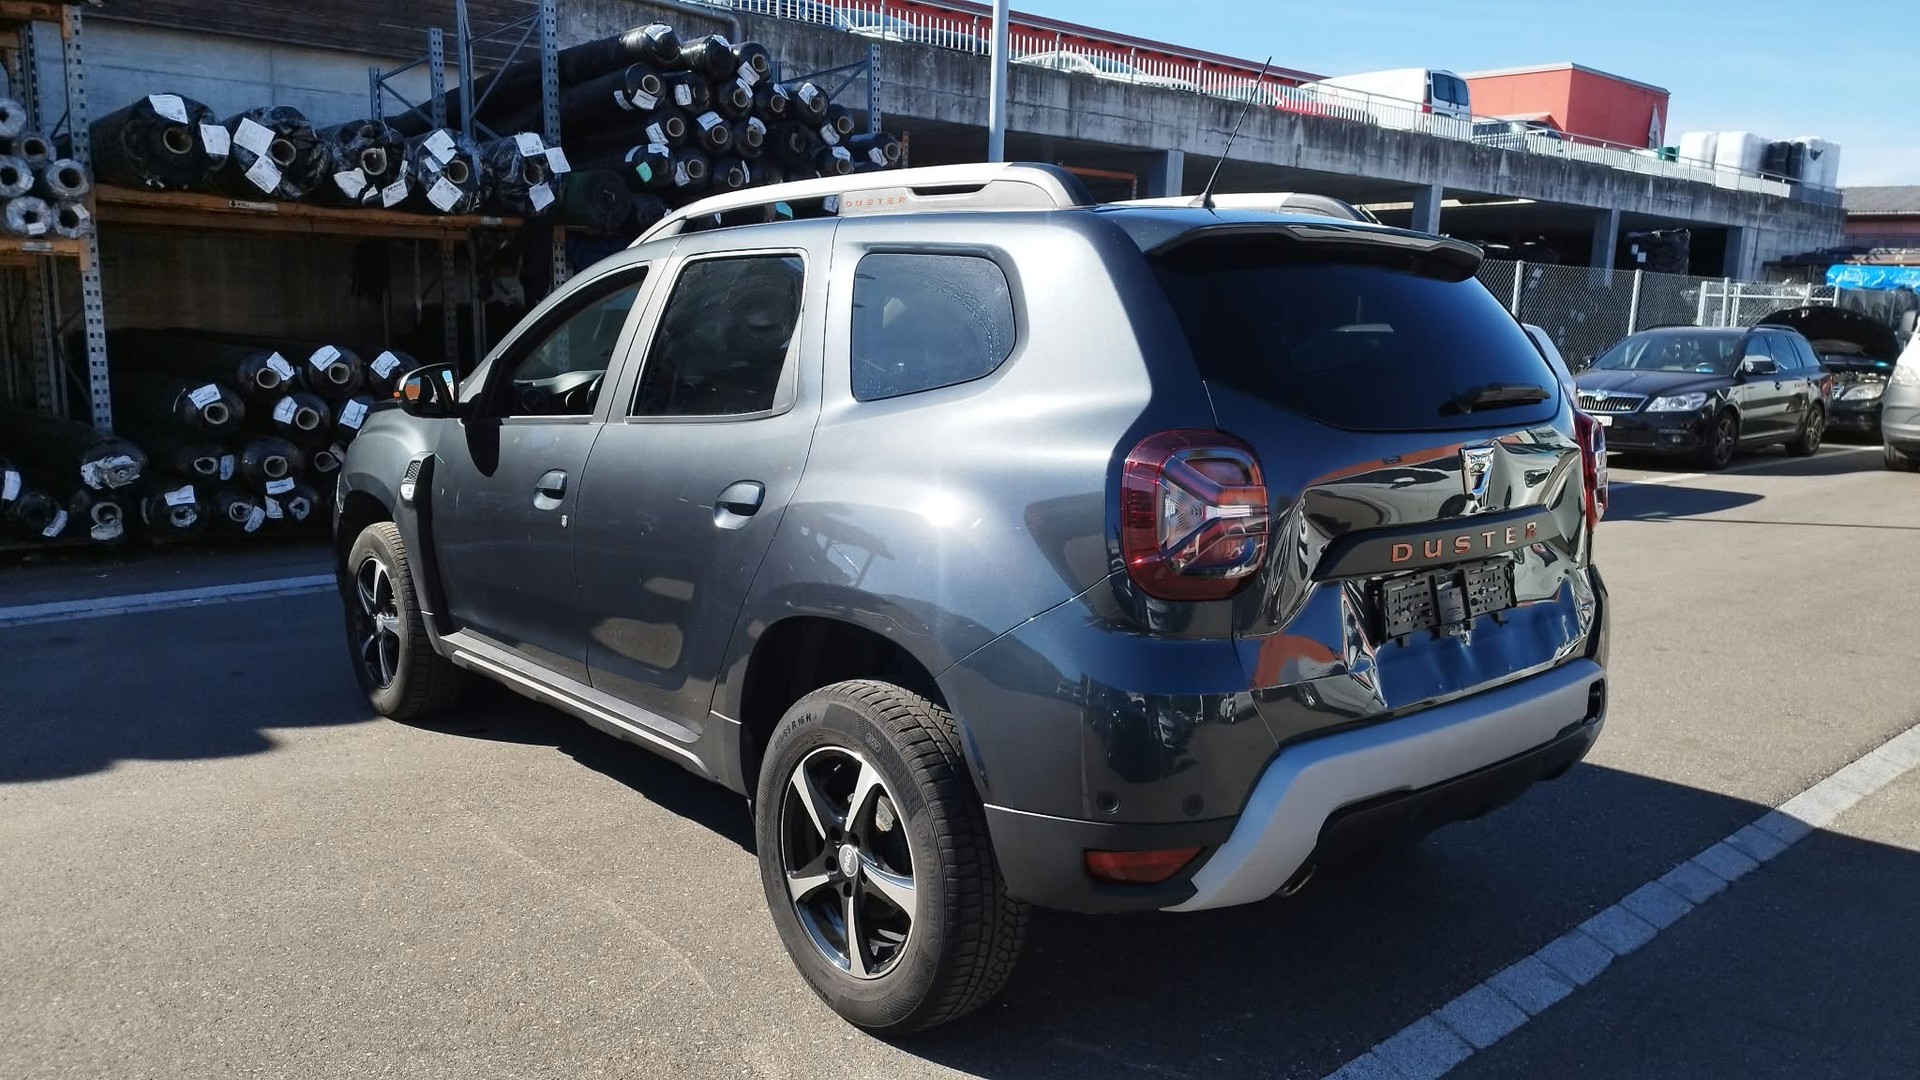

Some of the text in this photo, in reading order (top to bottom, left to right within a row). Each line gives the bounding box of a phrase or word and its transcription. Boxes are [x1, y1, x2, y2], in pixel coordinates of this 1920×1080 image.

[845, 196, 906, 207] DUSTER
[1391, 521, 1537, 562] DUSTER
[791, 720, 797, 730] R
[797, 716, 804, 727] 16
[805, 713, 812, 723] H
